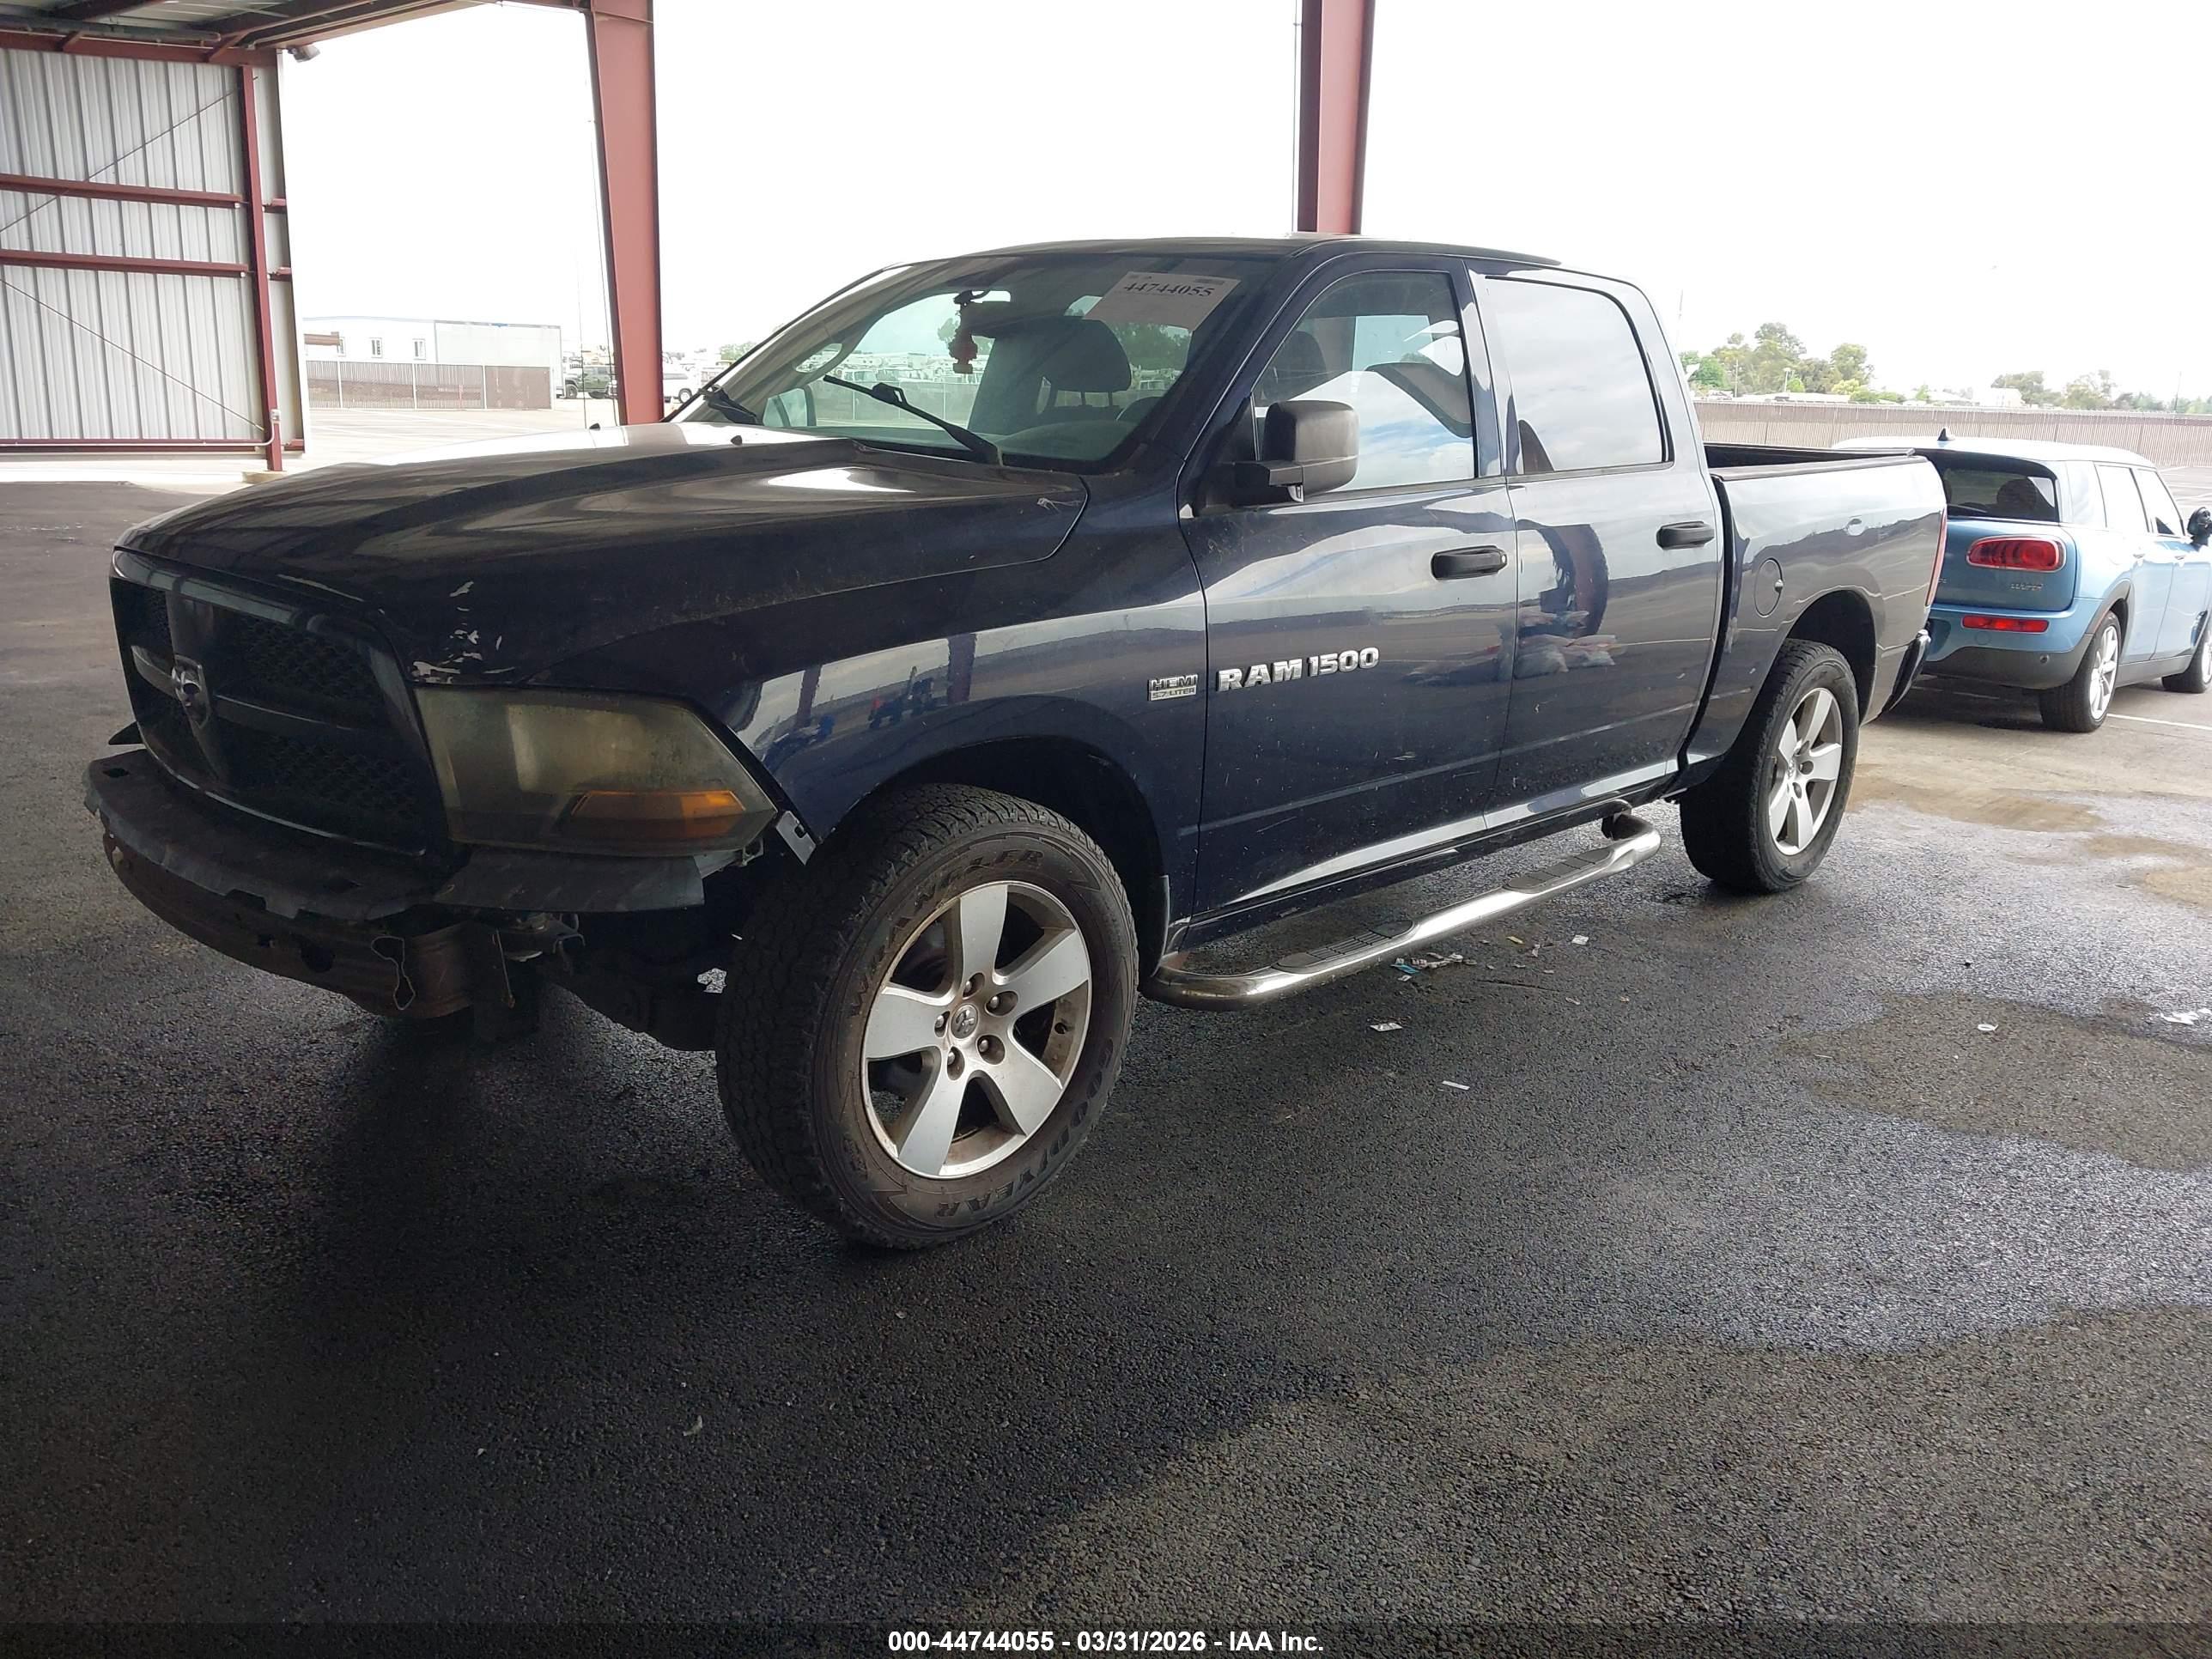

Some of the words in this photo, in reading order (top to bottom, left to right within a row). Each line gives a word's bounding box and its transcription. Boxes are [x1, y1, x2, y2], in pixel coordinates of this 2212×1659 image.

[1123, 282, 1215, 297] 44744055
[1216, 659, 1303, 692] RAM
[1308, 647, 1380, 677] 1500
[1150, 674, 1199, 691] HEMI
[1168, 688, 1196, 698] LITER
[934, 1037, 1114, 1218] GOODYEAR
